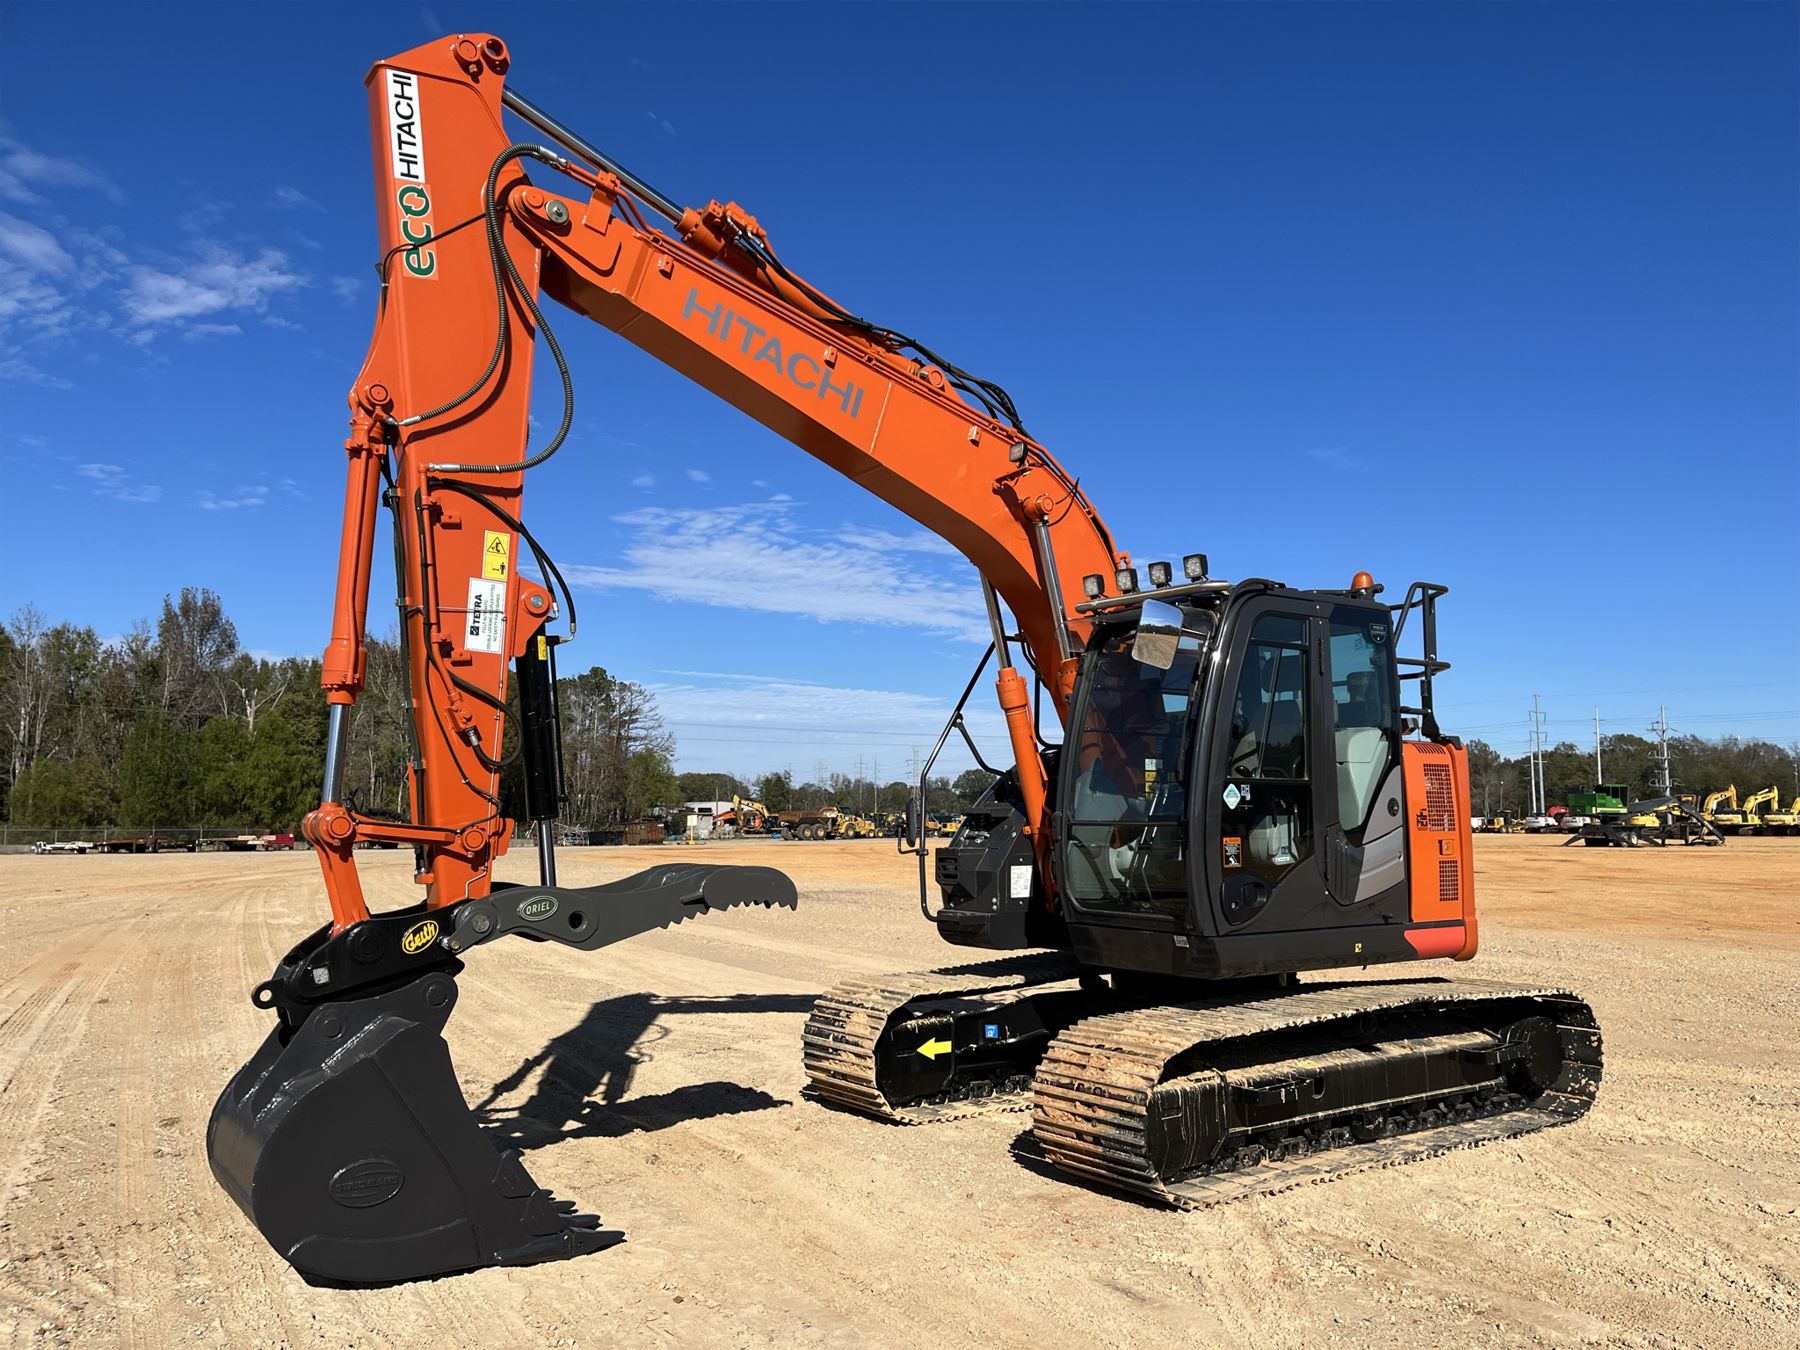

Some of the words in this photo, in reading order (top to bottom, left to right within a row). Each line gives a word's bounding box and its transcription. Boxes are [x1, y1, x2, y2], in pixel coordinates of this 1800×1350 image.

[393, 73, 419, 180] HITACHI
[682, 287, 864, 418] HITACHI
[472, 594, 483, 625] TETRA
[525, 901, 550, 915] ORIEL
